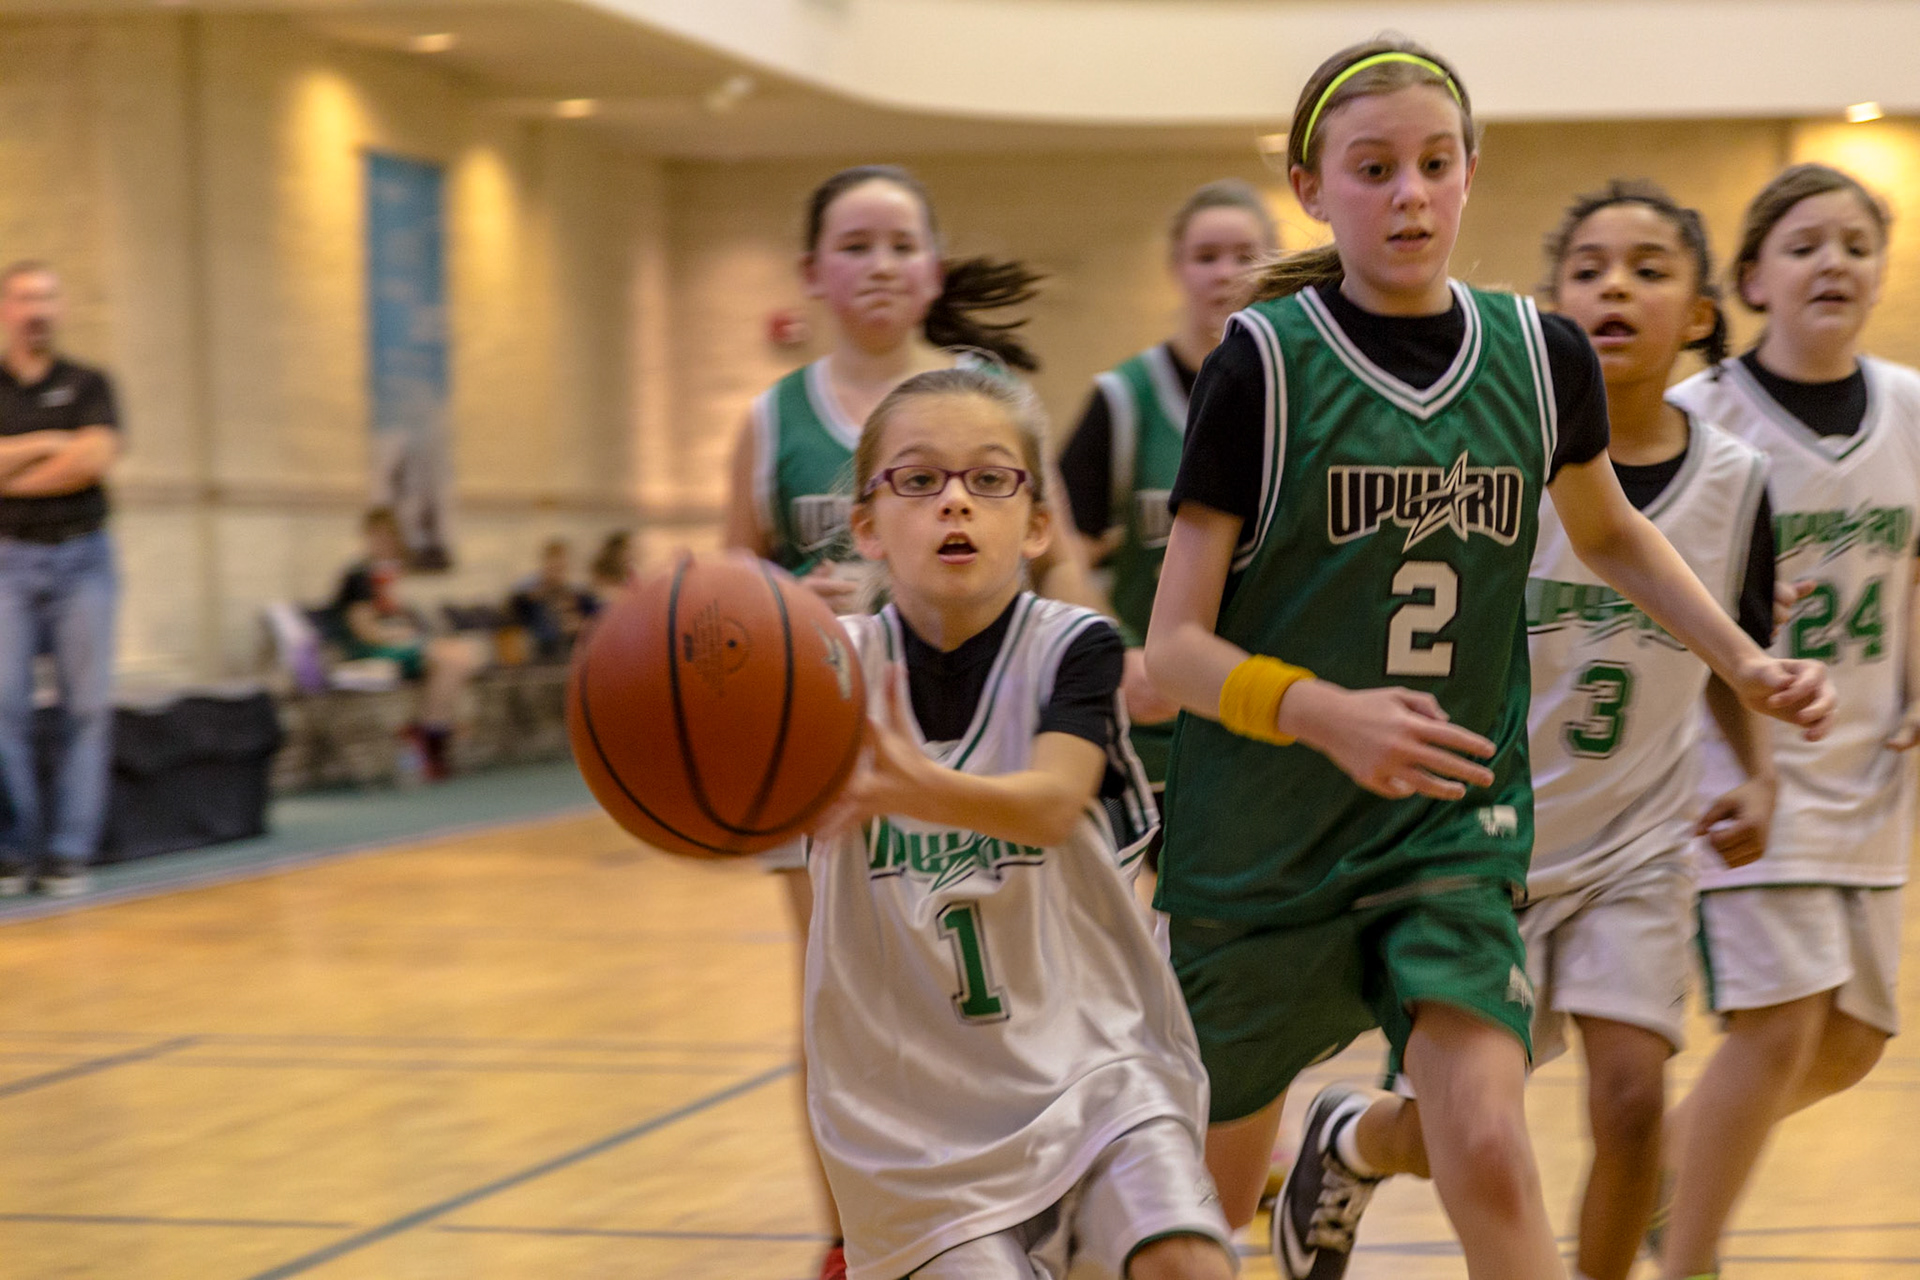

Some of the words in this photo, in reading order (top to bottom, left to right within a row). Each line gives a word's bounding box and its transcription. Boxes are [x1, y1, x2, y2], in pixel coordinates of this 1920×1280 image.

[1328, 449, 1525, 554] UPWARD
[1384, 558, 1460, 678] 2
[1789, 575, 1888, 665] 24
[1562, 659, 1638, 760] 3
[936, 900, 1011, 1026] 1
